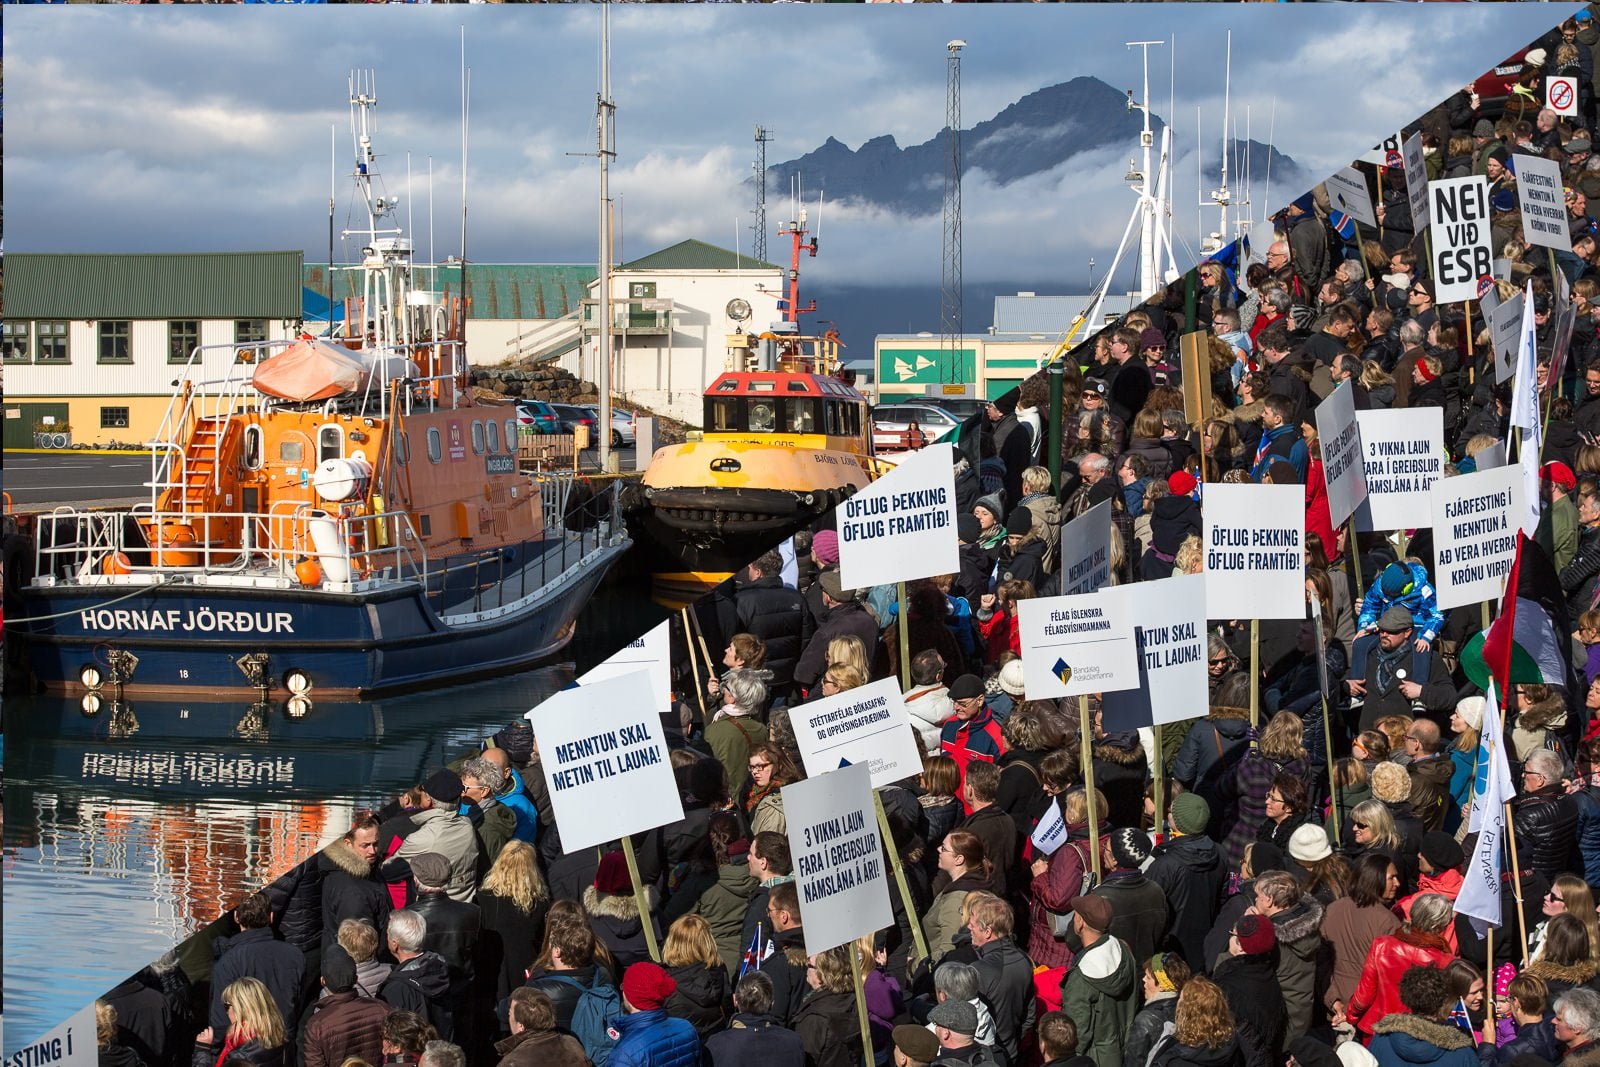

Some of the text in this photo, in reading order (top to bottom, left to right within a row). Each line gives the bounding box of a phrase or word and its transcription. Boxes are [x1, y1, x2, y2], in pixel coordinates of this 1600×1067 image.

[1435, 183, 1486, 225] NEI
[1447, 222, 1479, 248] VIÐ
[1438, 246, 1491, 285] ESB
[1369, 440, 1430, 456] 3 VIKNA LAUN
[1386, 457, 1390, 474] Í
[1392, 458, 1439, 474] GREIÐSLUR
[1366, 476, 1412, 494] ÁMSLÁNA
[1414, 474, 1420, 492] Á
[846, 487, 947, 518] ÖFLUG ÞEKKING
[1445, 486, 1512, 518] FJÁRFESTING Í
[843, 507, 950, 542] ÖFLUG FRAMTÍÐ!
[1212, 524, 1298, 546] ÖFLUG ÞEKKING
[1453, 510, 1507, 540] MENNTUN Á
[1208, 548, 1300, 570] ÖFLUG FRAMTÍÐ!
[1439, 549, 1452, 566] AÐ
[1454, 543, 1480, 562] VERA
[1451, 564, 1484, 586] KRÓNU
[81, 607, 295, 633] HORNAFJÖRÐUR
[1044, 620, 1111, 636] FÉLAGSVÍSINDAMANNA
[1050, 607, 1103, 622] FÉLAG ÍSLENSKRA
[1171, 622, 1198, 645] SKAL
[1146, 651, 1163, 670] TIL
[1165, 644, 1201, 666] LAUNA!
[179, 669, 189, 679] 18
[809, 696, 888, 729] STÉTTARFÉLAG BÓKASAFNS-
[817, 708, 891, 740] OG UPPLÝSINGAFRÆÐINGA
[555, 722, 652, 765] MENNTUN SKAL
[552, 745, 662, 792] METIN TIL LAUNA!
[804, 809, 865, 848] 3 VIKNA LAUN
[798, 832, 877, 878] FARA Í GREIÐSLUR
[803, 857, 880, 904] NÁMSLÁNA Á ÁRI!
[67, 1027, 72, 1056] Í
